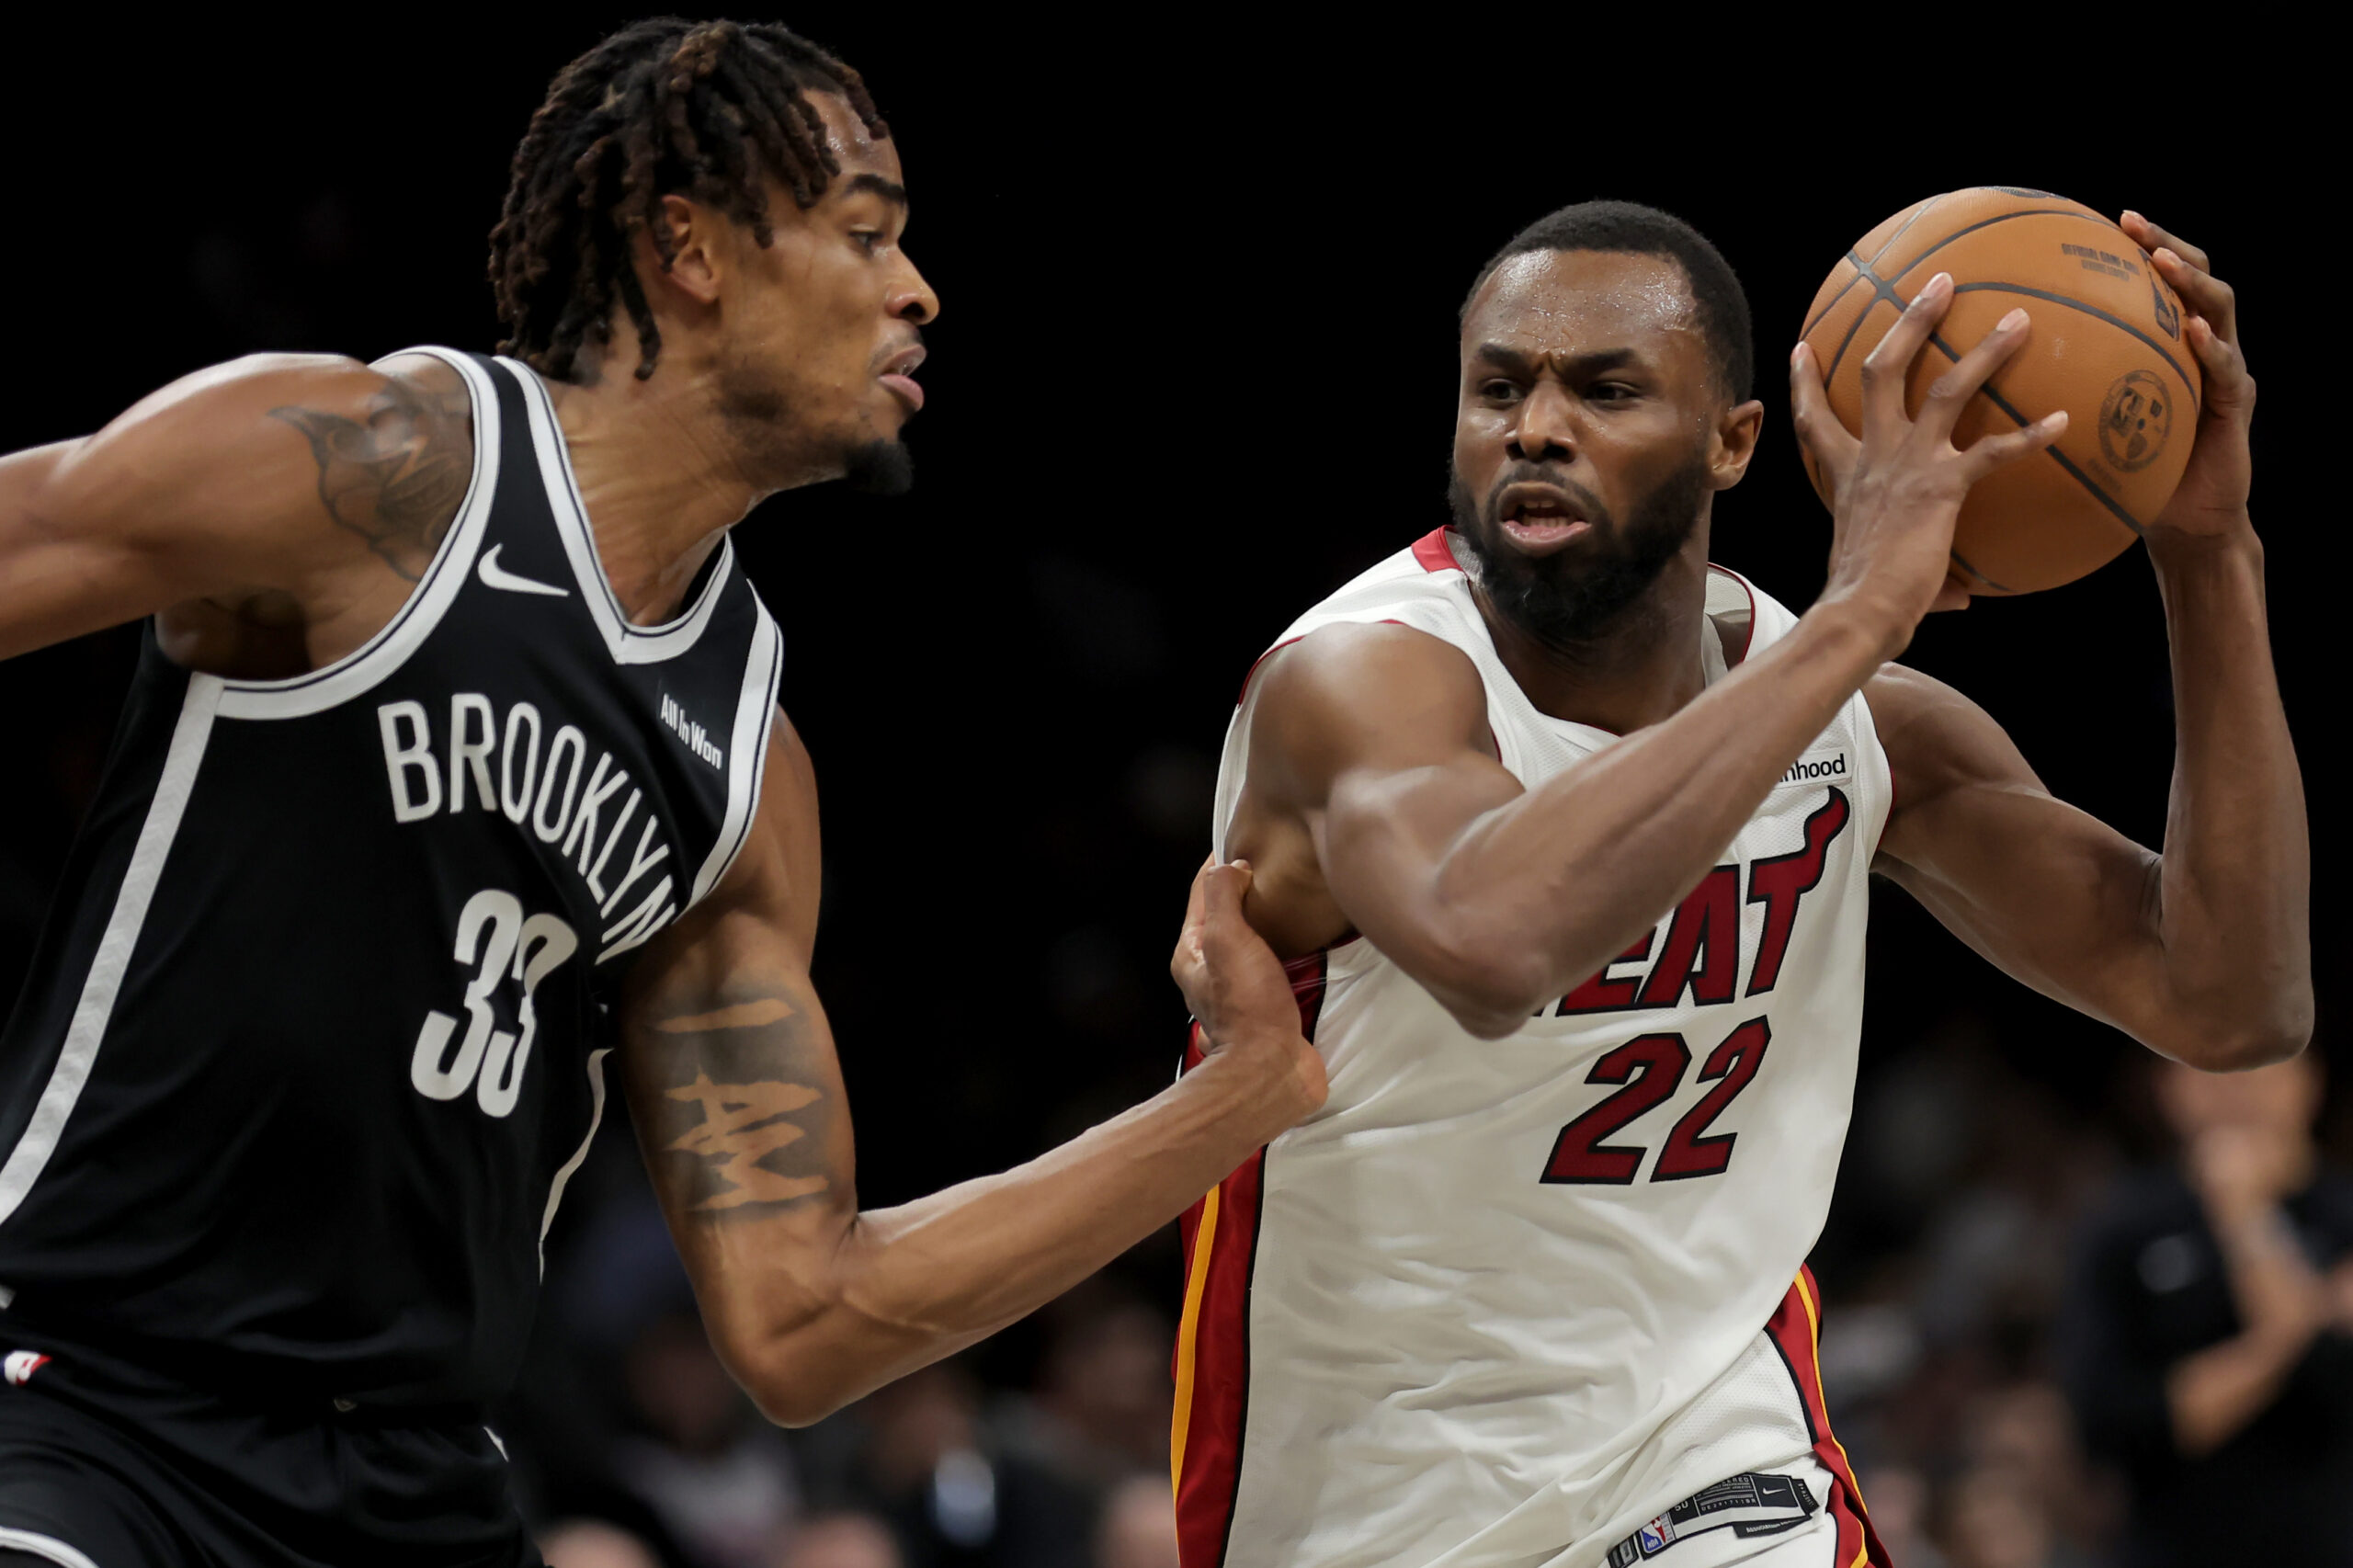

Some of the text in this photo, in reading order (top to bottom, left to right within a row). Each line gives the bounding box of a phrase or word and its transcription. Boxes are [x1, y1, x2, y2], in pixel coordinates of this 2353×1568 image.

[378, 692, 676, 966] BROOKLYN
[661, 692, 723, 770] All In Won
[1779, 753, 1847, 782] nhood
[1532, 785, 1850, 1017] EAT
[410, 888, 579, 1119] 33
[1538, 1014, 1772, 1186] 22
